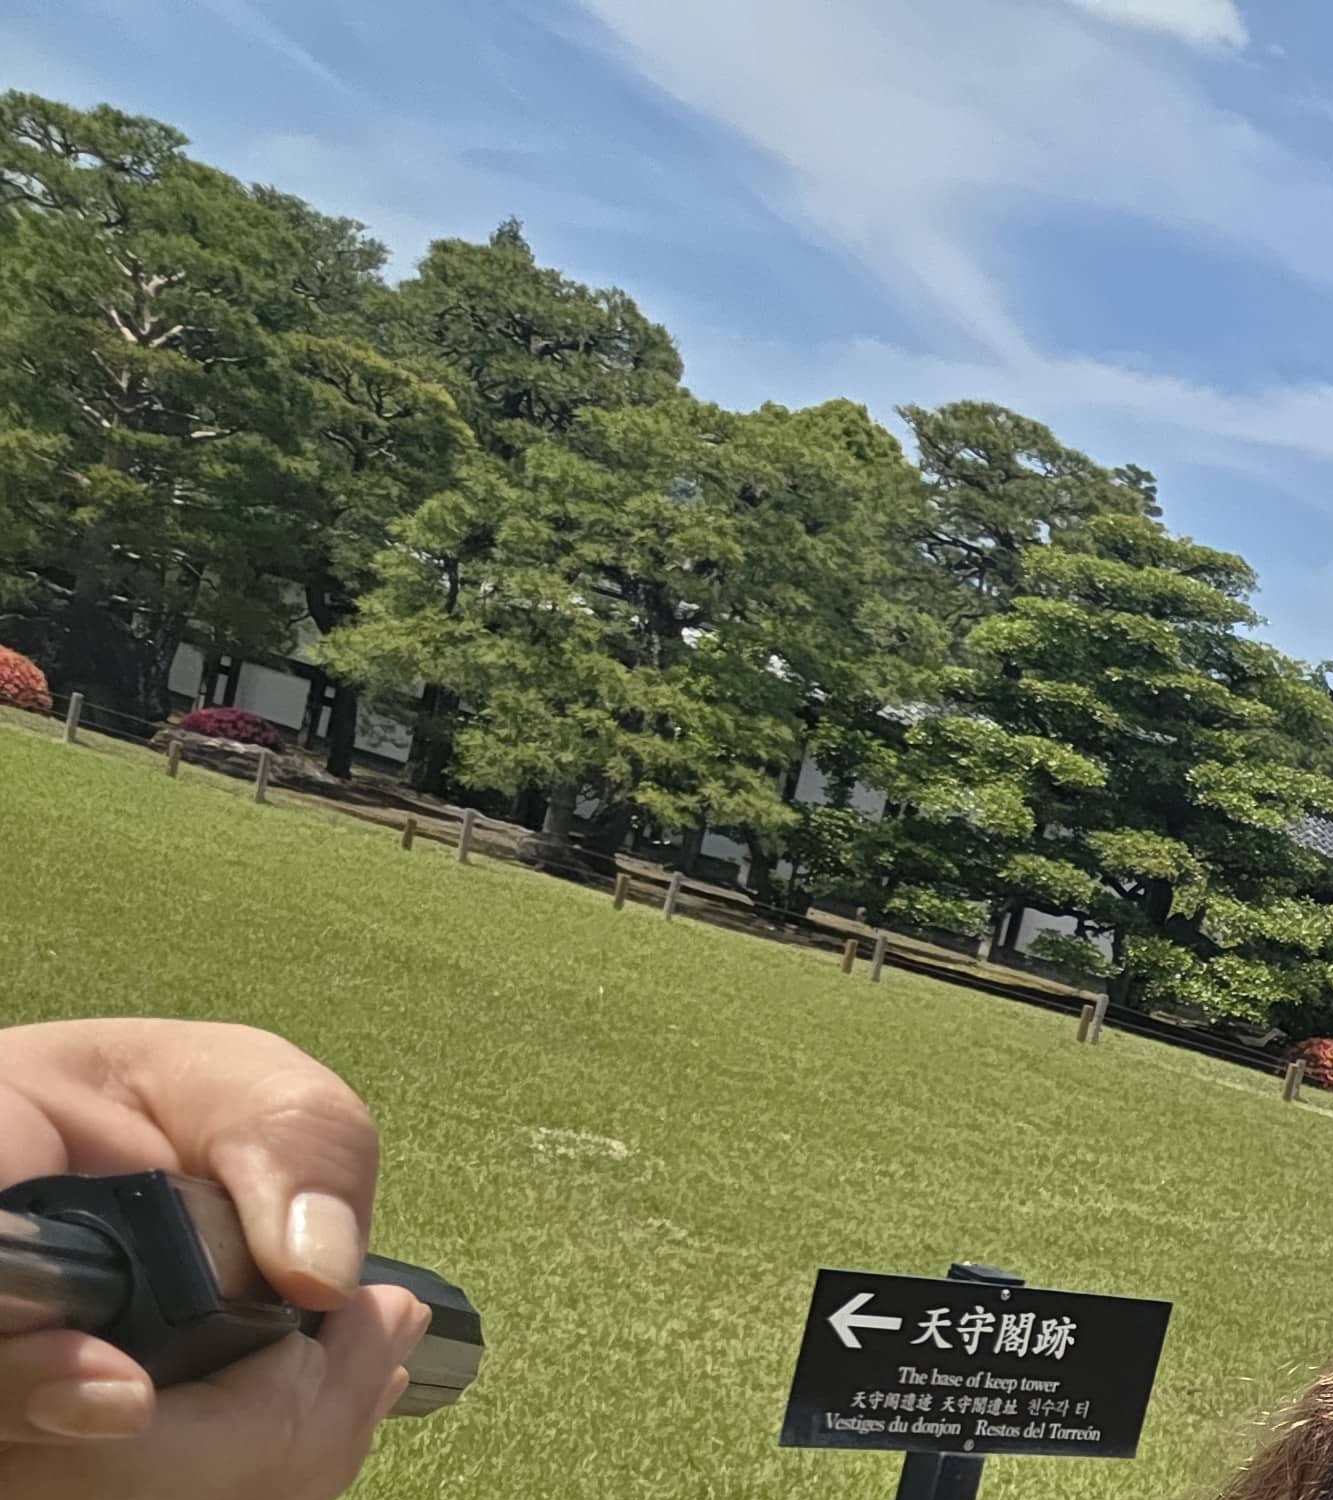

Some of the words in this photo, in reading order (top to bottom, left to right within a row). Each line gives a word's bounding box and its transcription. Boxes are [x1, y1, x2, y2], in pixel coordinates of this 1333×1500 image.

[909, 1305, 1078, 1360] 天守閣跡
[898, 1366, 929, 1386] The
[929, 1367, 964, 1388] base
[965, 1371, 985, 1389] of
[983, 1372, 1018, 1394] keep
[1019, 1377, 1061, 1393] tower
[1074, 1400, 1091, 1420] 터
[825, 1412, 886, 1435] Vestiges
[887, 1415, 910, 1433] du
[911, 1416, 961, 1438] donjon
[974, 1419, 1021, 1438] Restos
[1022, 1421, 1047, 1439] del
[1048, 1422, 1101, 1442] Torreón
